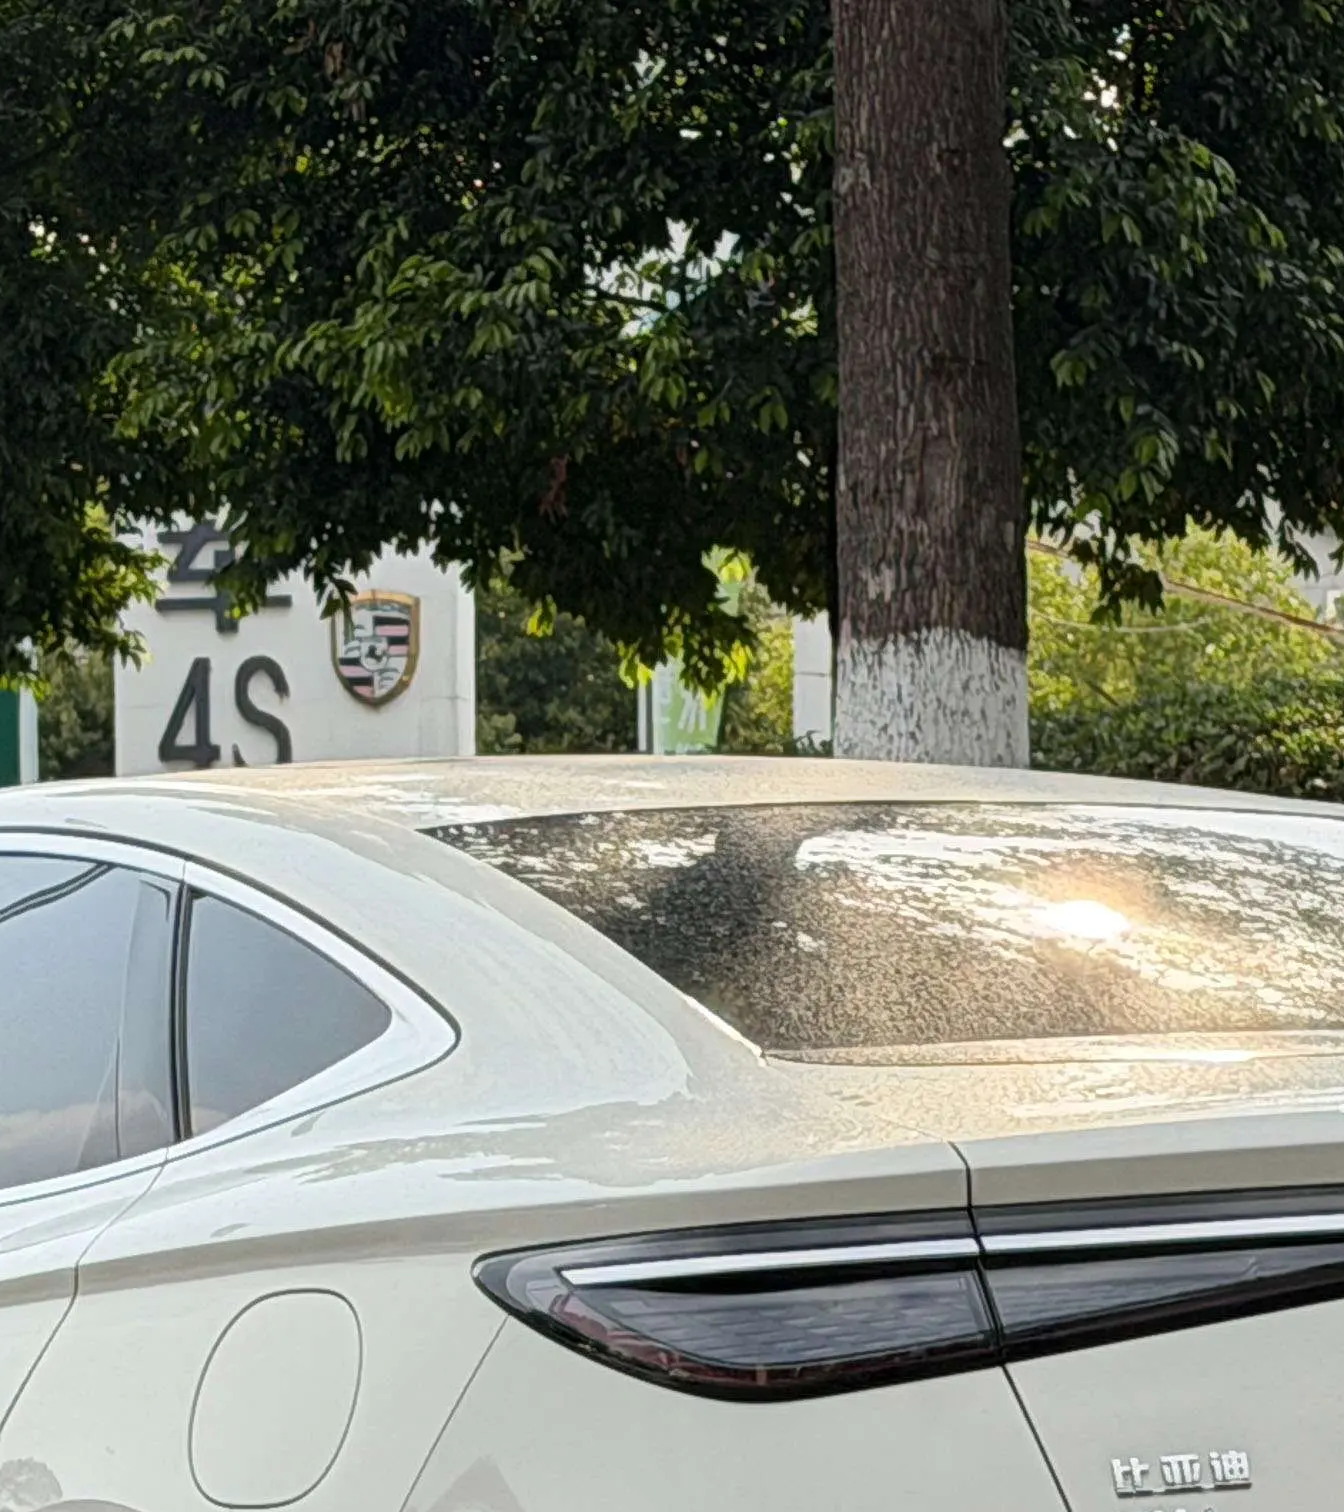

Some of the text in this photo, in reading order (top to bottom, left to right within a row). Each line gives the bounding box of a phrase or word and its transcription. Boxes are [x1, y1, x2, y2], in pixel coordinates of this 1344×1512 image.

[158, 655, 293, 768] 4S
[1111, 1449, 1252, 1498] 比亚迪
